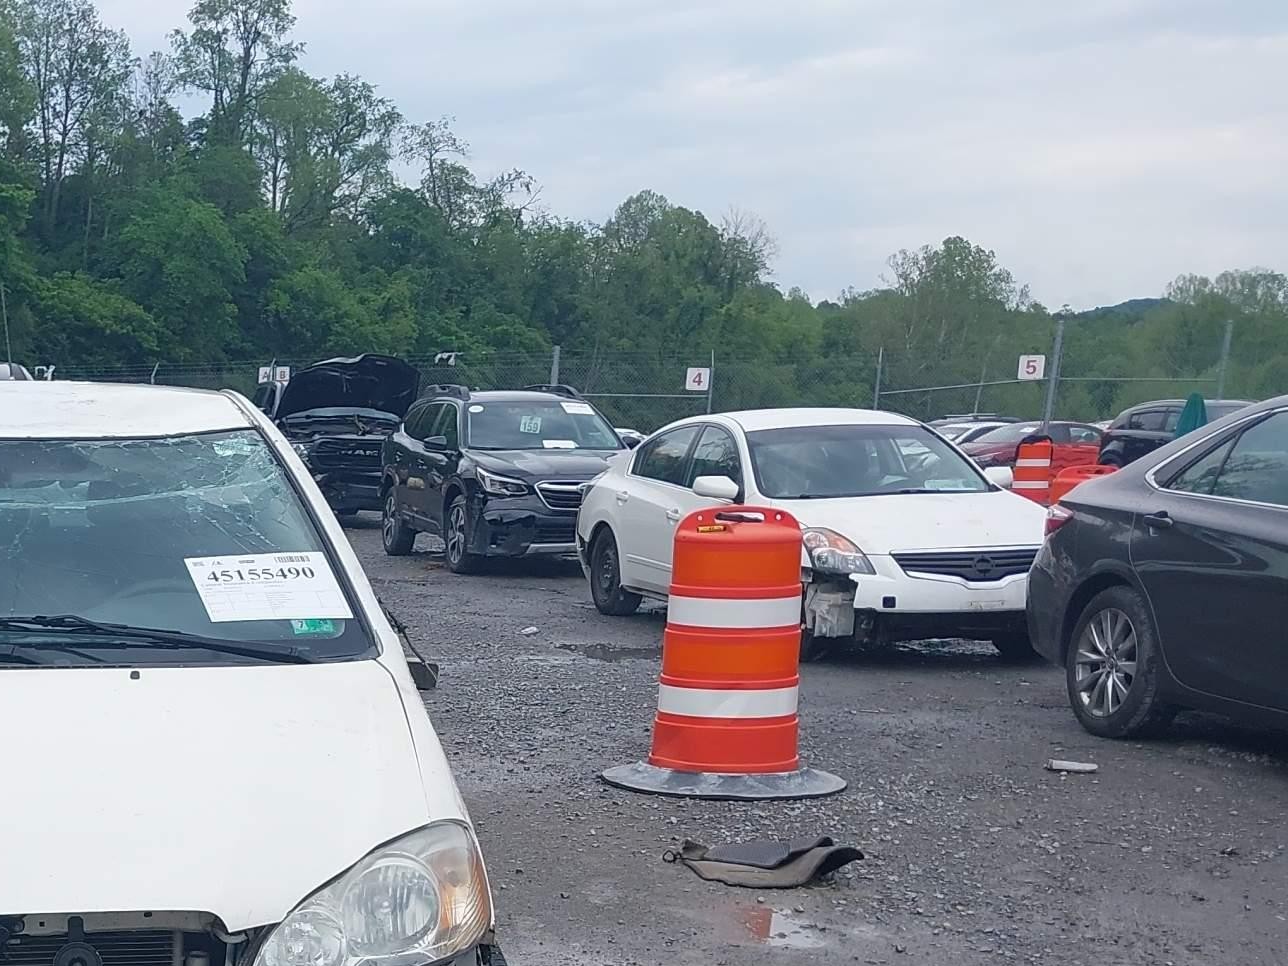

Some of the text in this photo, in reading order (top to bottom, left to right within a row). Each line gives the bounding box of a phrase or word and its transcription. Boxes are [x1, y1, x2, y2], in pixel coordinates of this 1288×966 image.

[280, 370, 286, 380] B
[1025, 359, 1038, 375] 5
[691, 371, 704, 387] 4
[207, 566, 315, 582] 45155490
